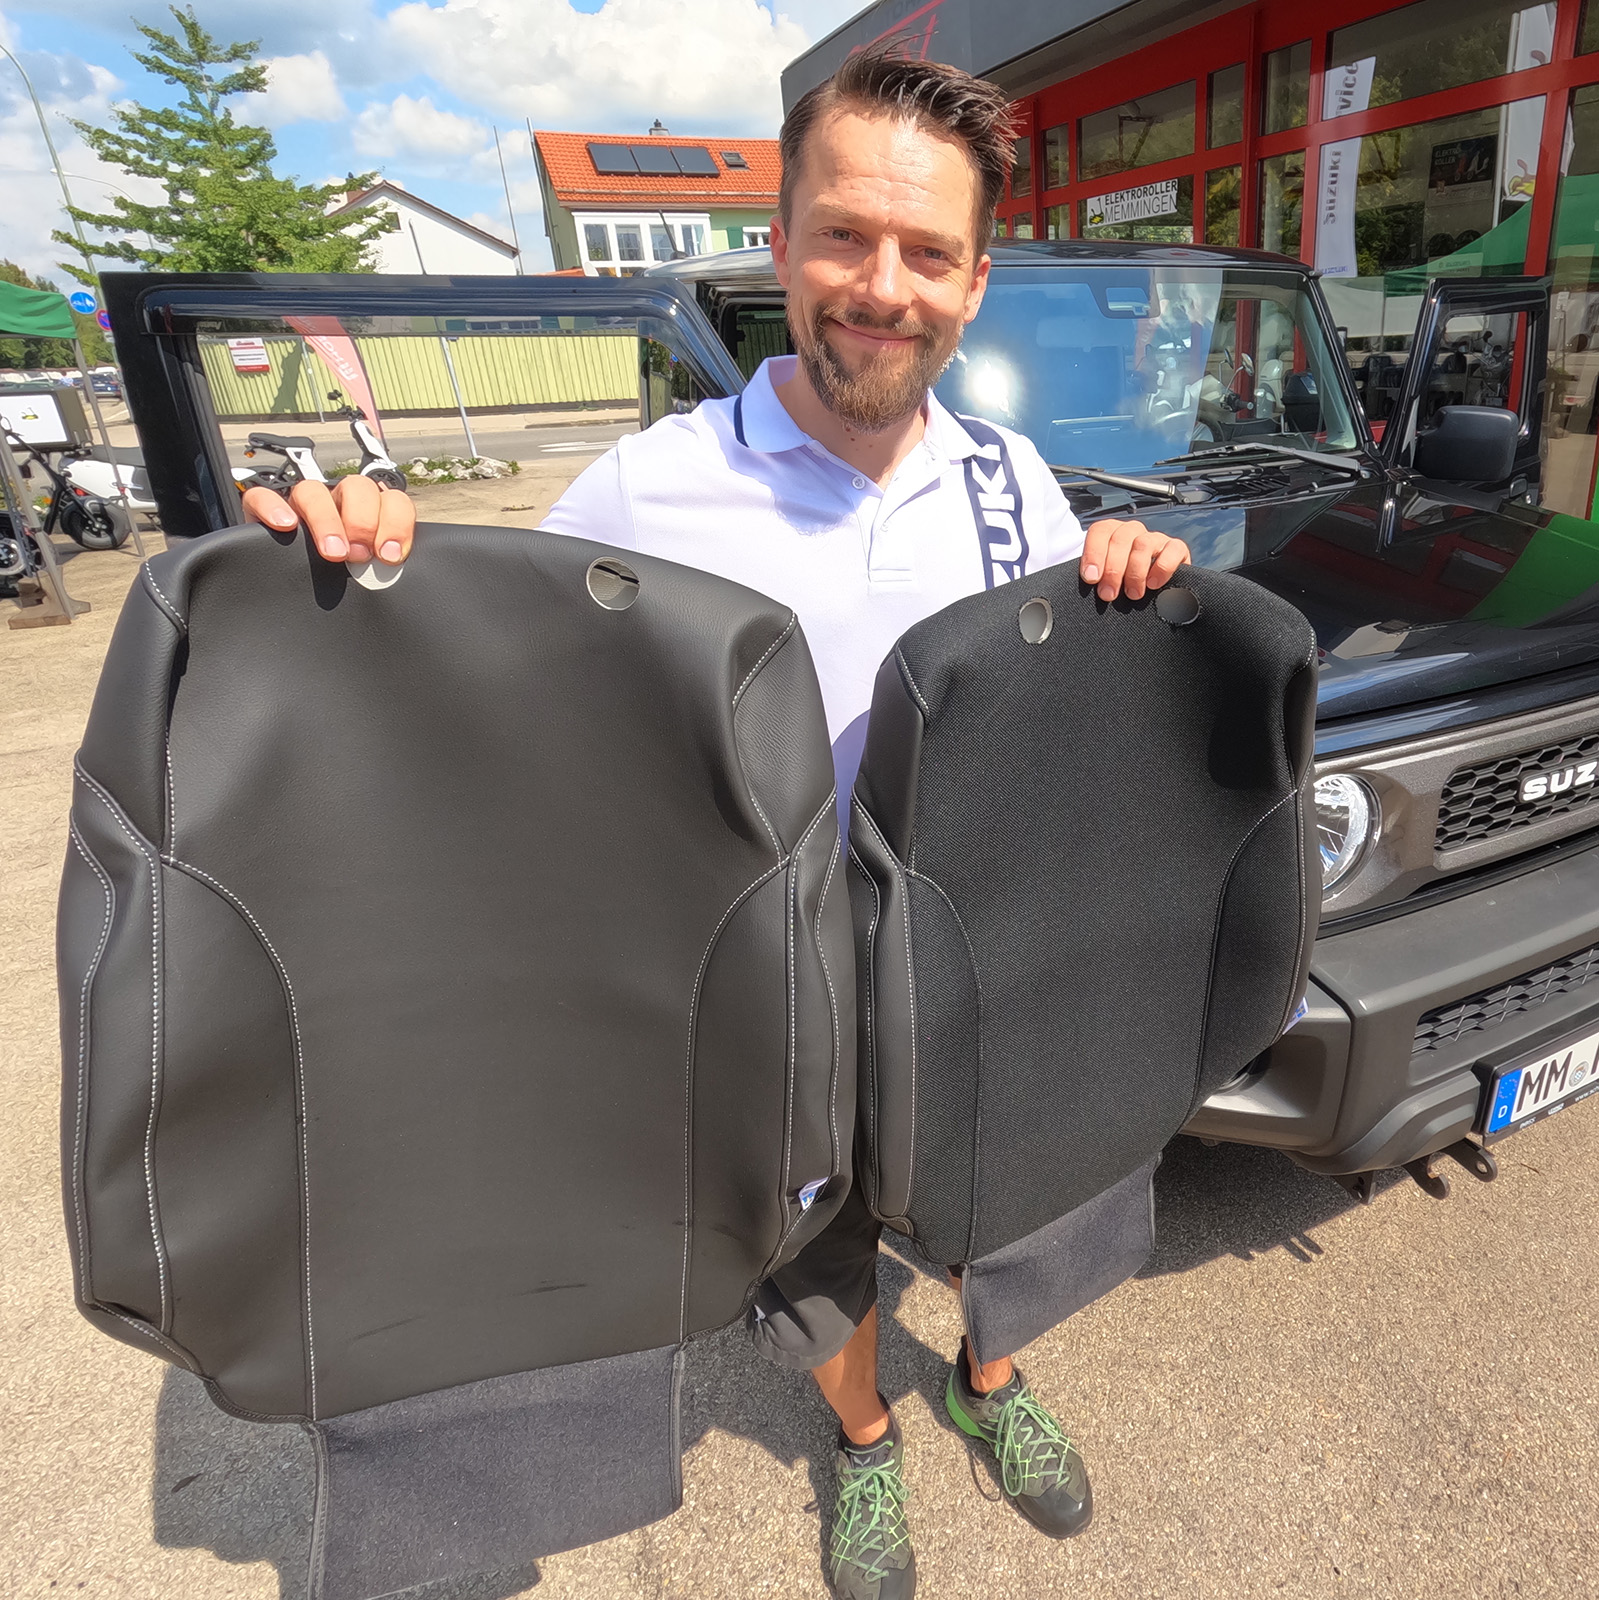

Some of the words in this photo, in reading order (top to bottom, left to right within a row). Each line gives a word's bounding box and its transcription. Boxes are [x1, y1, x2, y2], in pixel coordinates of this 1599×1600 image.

[1105, 180, 1177, 205] ELEKTROROLLER
[1104, 194, 1178, 222] MEMMINGEN
[1498, 1105, 1508, 1118] D
[1516, 1051, 1573, 1113] MM
